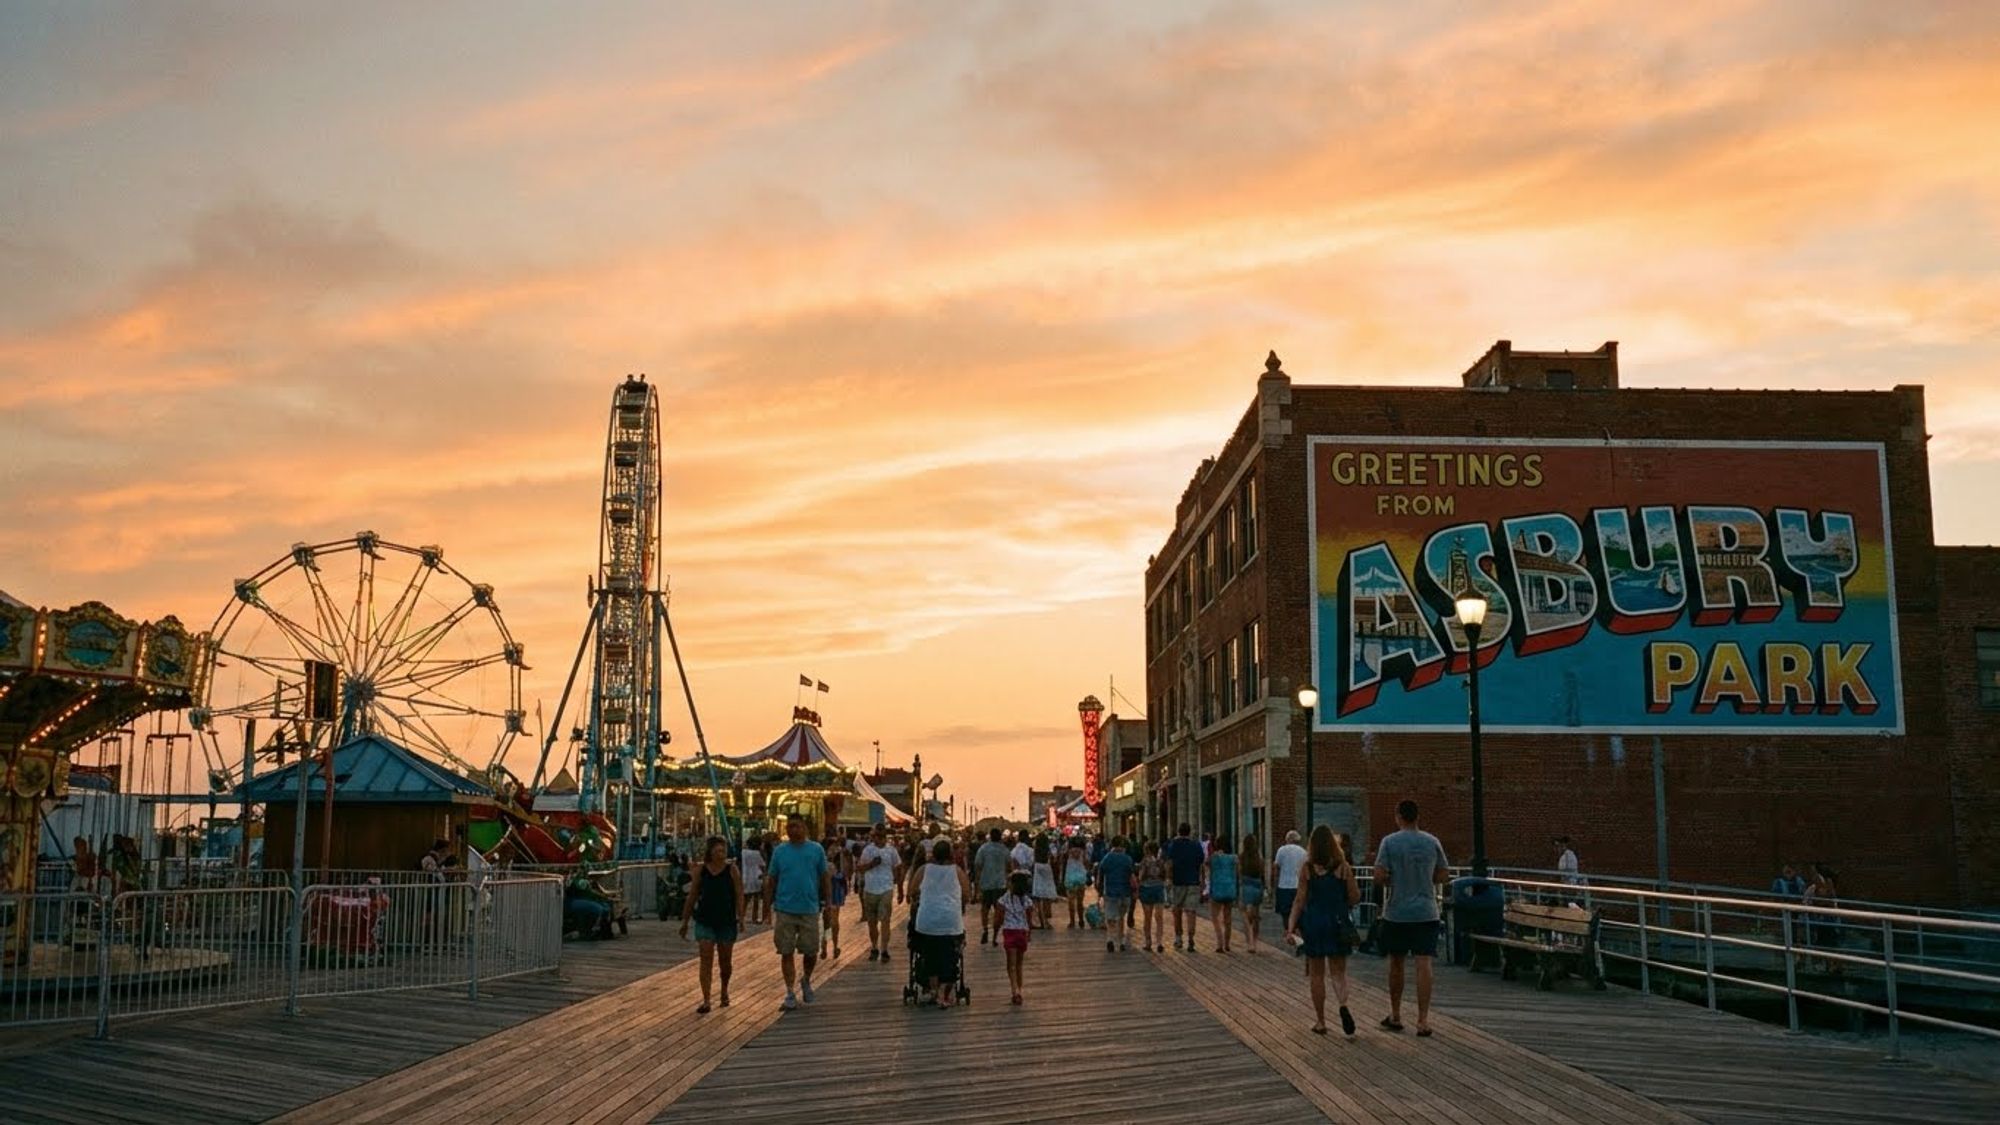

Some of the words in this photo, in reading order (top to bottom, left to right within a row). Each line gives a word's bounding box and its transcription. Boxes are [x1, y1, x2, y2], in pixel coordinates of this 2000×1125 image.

[1331, 452, 1544, 487] GREETINGS
[1377, 495, 1456, 515] FROM
[1338, 505, 1859, 718] ASBURY
[1647, 641, 1879, 714] PARK
